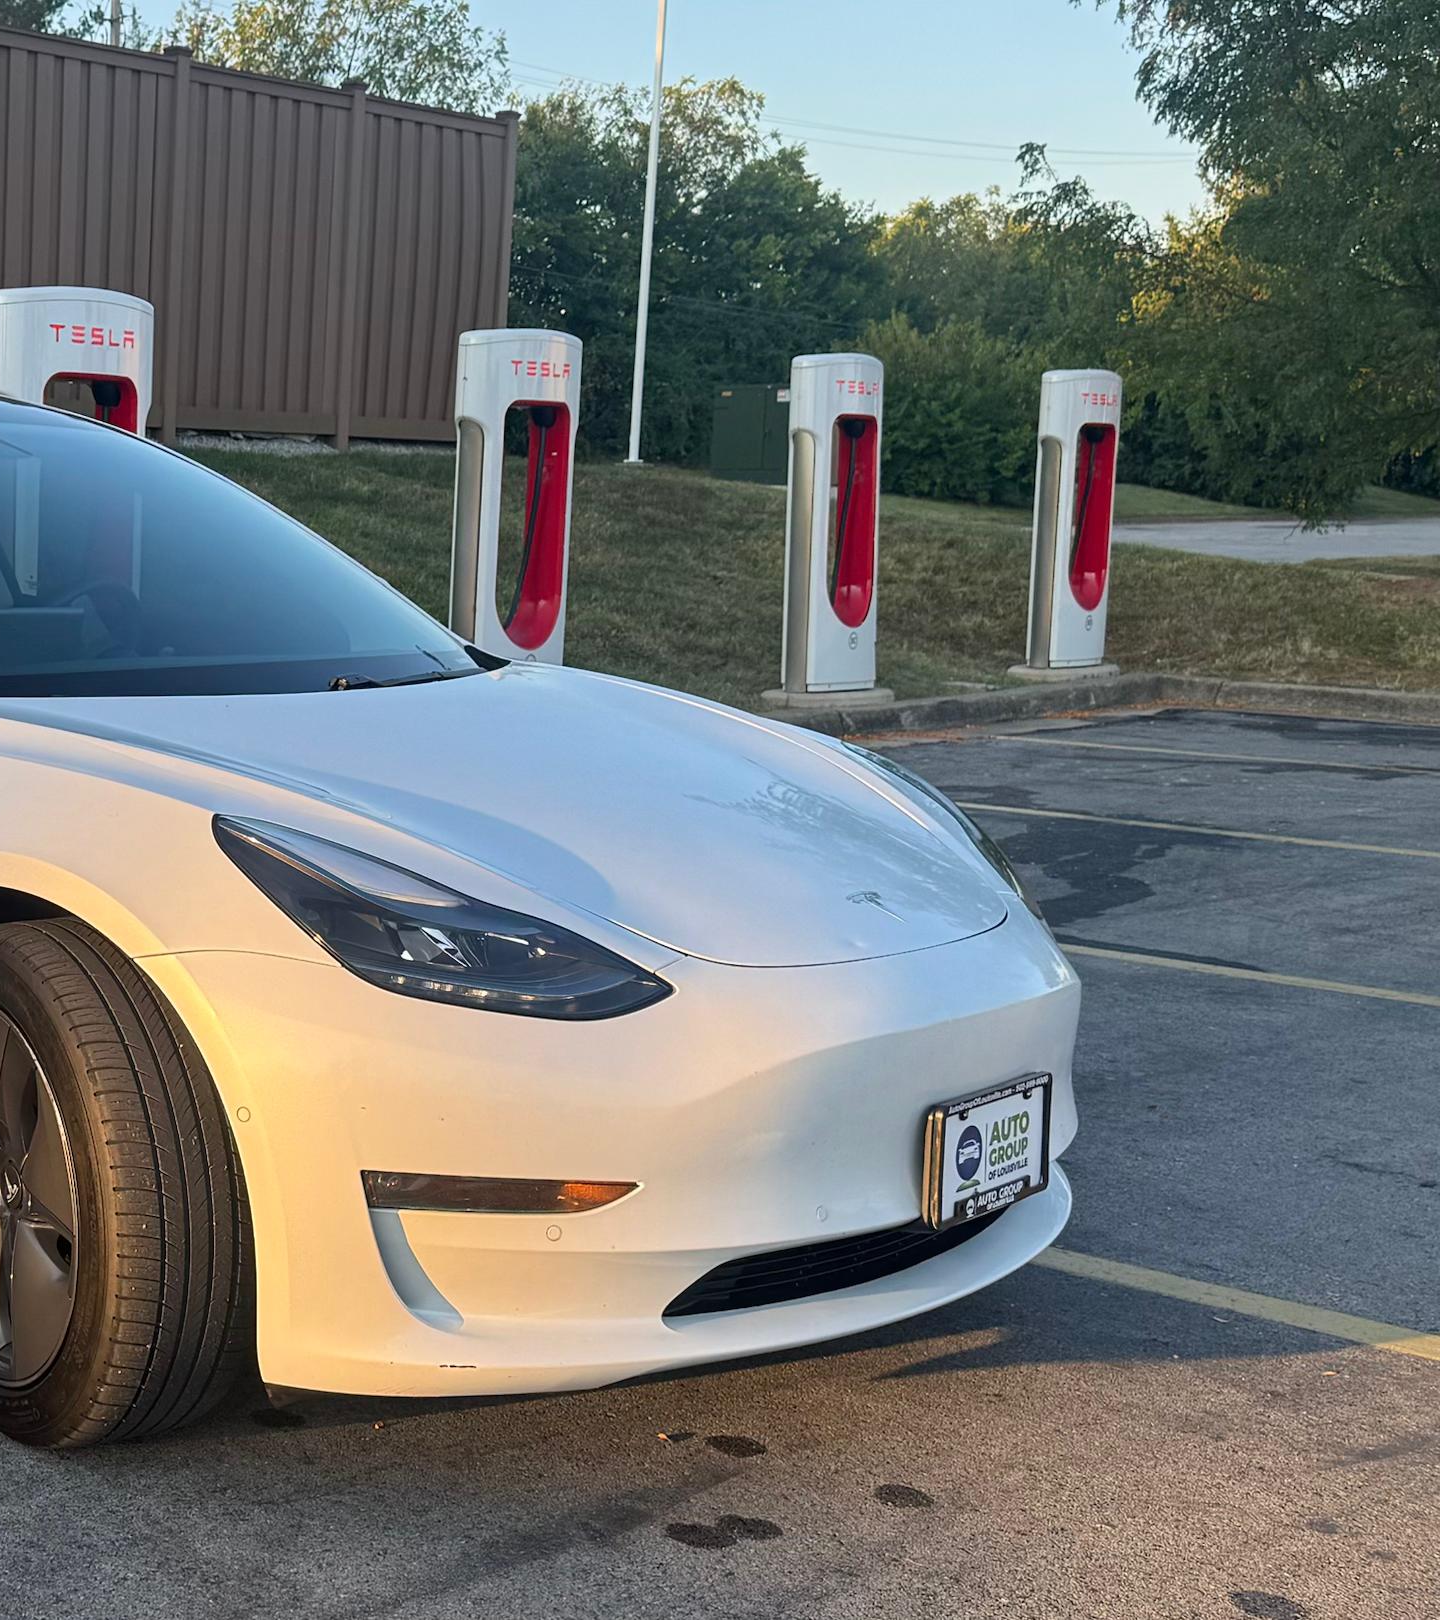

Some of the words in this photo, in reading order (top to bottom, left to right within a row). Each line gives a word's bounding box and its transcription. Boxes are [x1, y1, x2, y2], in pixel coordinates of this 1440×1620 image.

[49, 323, 135, 349] TESLA
[511, 359, 571, 379] TESLA
[835, 379, 880, 395] TESLA
[1080, 393, 1118, 406] TESLA
[989, 1111, 1029, 1146] AUTO
[989, 1137, 1028, 1167] GROUP
[988, 1169, 997, 1180] OF
[997, 1157, 1028, 1177] LOUISVILLE
[977, 1191, 997, 1207] AUTO
[999, 1181, 1024, 1199] GROUP
